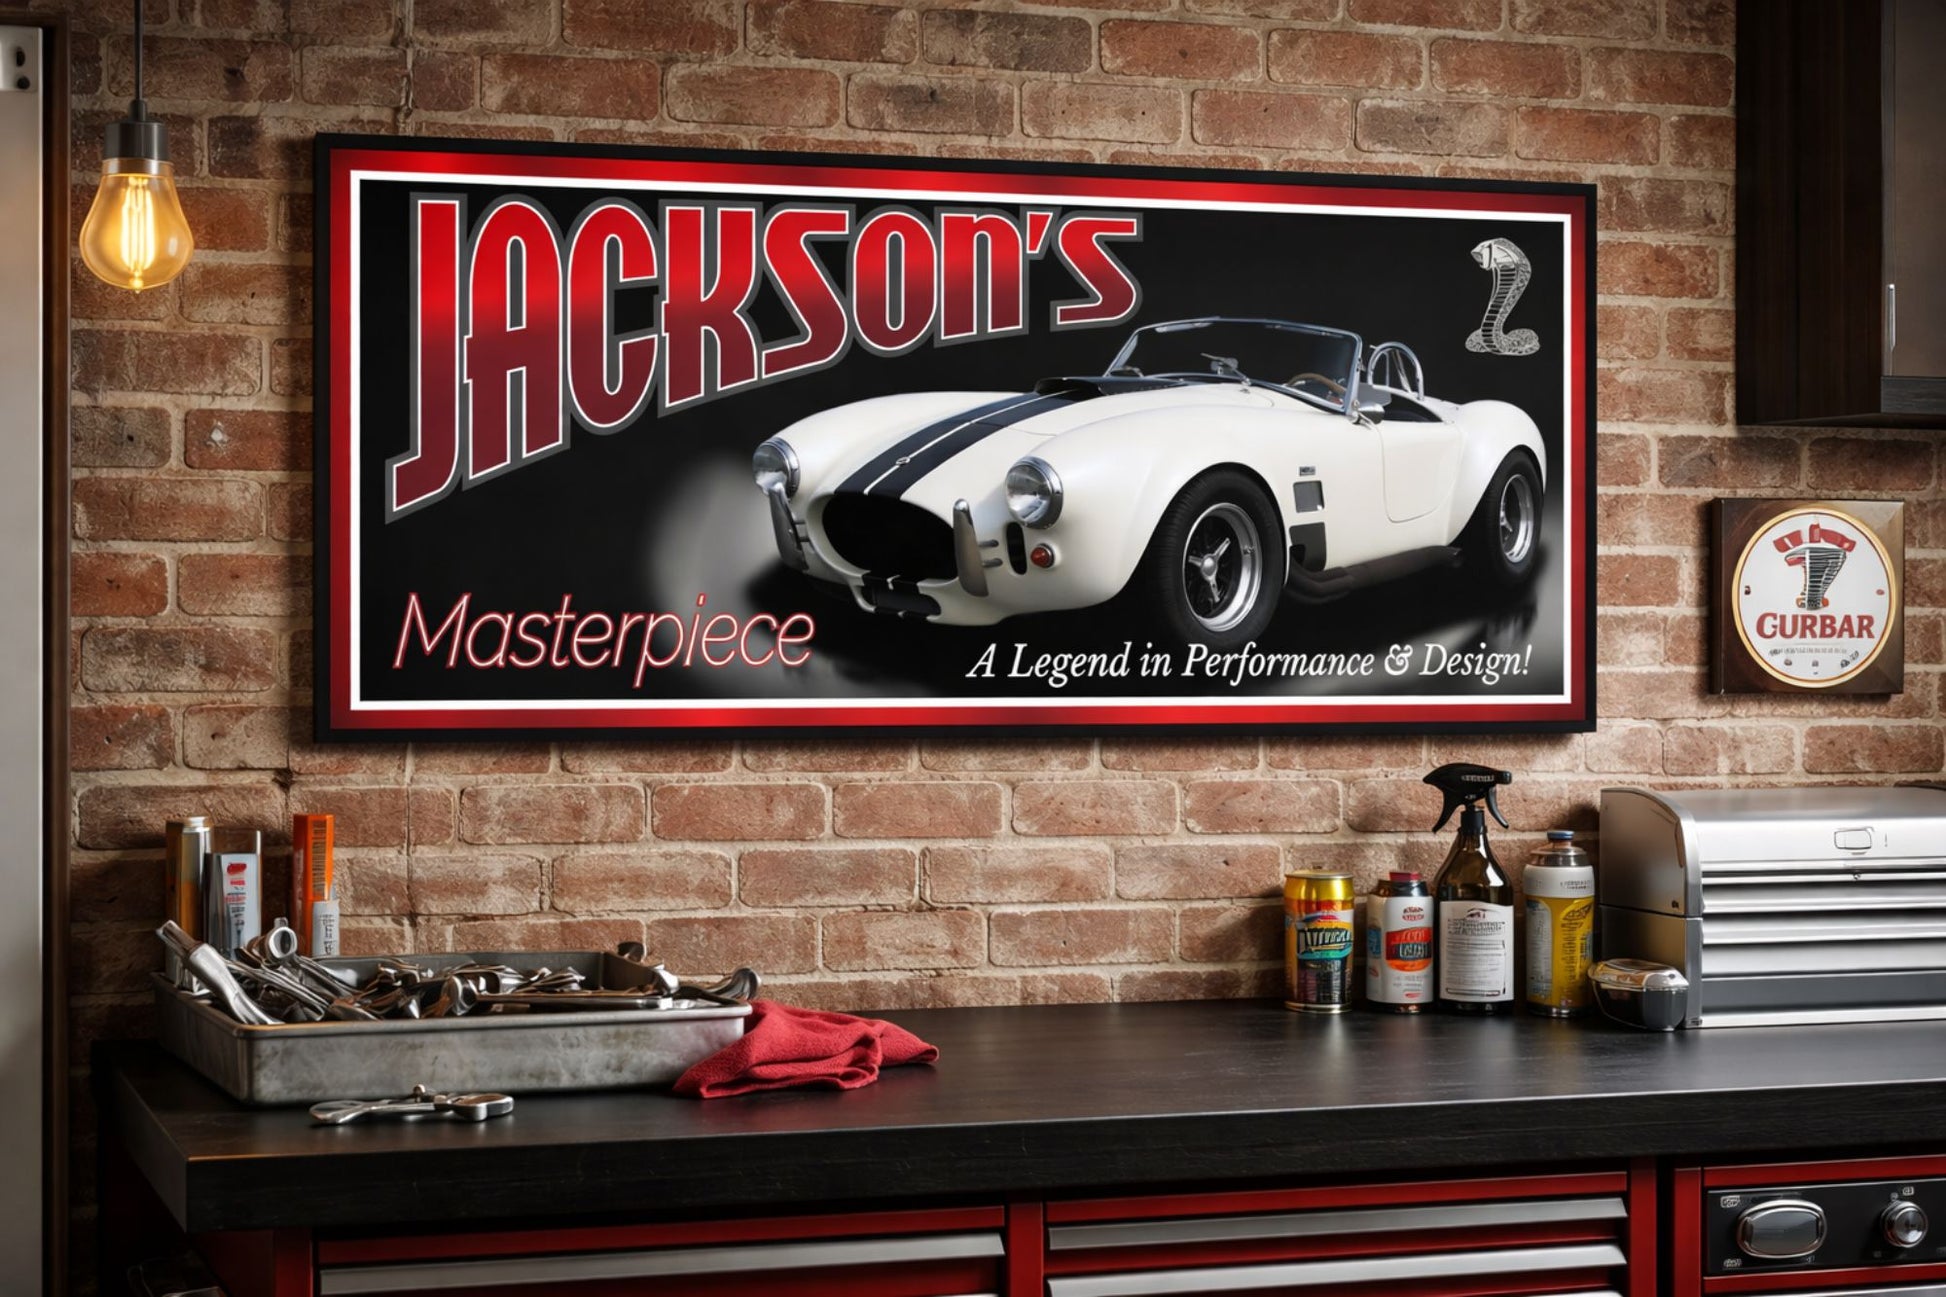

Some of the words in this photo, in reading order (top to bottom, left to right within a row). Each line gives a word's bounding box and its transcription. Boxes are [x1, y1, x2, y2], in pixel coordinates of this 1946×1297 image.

[392, 592, 815, 688] Masterpiece
[1756, 612, 1875, 639] GURBAR
[965, 643, 996, 677] A
[1007, 643, 1131, 687] Legend
[1140, 642, 1172, 676] in
[1181, 642, 1375, 686] Performance
[1383, 643, 1413, 676] &
[1418, 642, 1533, 685] Design!
